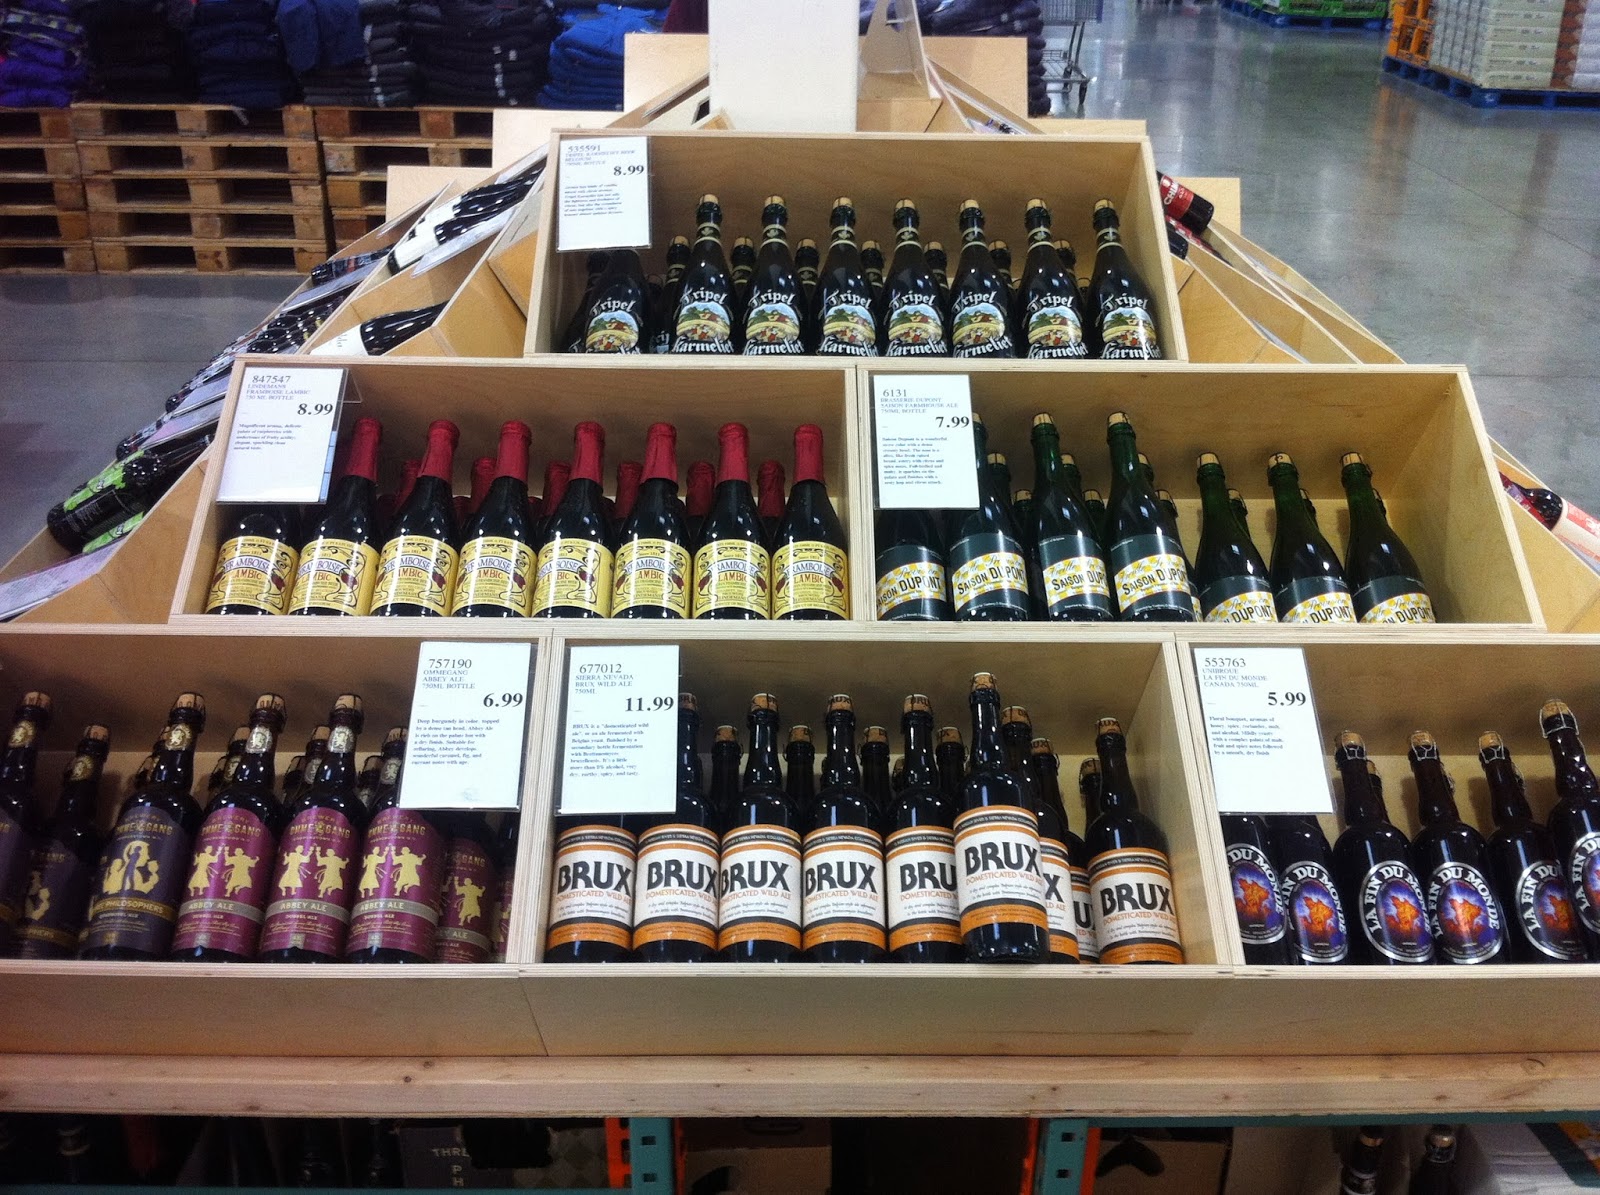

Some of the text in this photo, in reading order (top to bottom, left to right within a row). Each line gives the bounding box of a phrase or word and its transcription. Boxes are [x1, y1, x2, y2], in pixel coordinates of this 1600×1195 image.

[568, 145, 601, 153] 535591
[613, 165, 644, 176] 8.99
[680, 287, 728, 305] Tripel
[750, 289, 796, 307] Tripel
[826, 289, 872, 309] Tripel
[889, 291, 936, 310] Tripel
[952, 291, 996, 313] Tripel
[1028, 292, 1073, 312] Tripel
[1102, 292, 1148, 311] Tripel
[592, 297, 636, 317] Tripel
[883, 389, 907, 397] 6131
[297, 403, 333, 415] 8.99
[936, 416, 969, 428] 7.99
[386, 556, 430, 571] FRMBOISE
[794, 574, 824, 584] LAMBIC
[957, 572, 988, 595] SAISON
[1052, 574, 1084, 591] SAISON
[1122, 569, 1187, 596] SAISON DUPON
[877, 576, 940, 609] AISON DUPONT
[1232, 604, 1273, 623] DUPONT
[1310, 605, 1353, 623] DUPONT
[1398, 605, 1435, 623] DUPONT
[429, 659, 472, 669] 757190
[579, 664, 622, 674] 677012
[1205, 658, 1246, 667] 553763
[483, 693, 523, 707] 6.99
[625, 696, 674, 712] 11.99
[1268, 692, 1306, 706] 5.99
[964, 841, 1042, 878] BRUX
[1572, 853, 1586, 883] FIN
[558, 860, 632, 898] BRUX
[647, 858, 718, 899] BRUX
[721, 861, 790, 898] BRUX
[805, 861, 877, 897] BRUX
[900, 861, 956, 892] BRU
[965, 871, 1034, 886] DOMESTICATED WILD
[1379, 865, 1404, 879] DU
[1228, 848, 1254, 862] DU
[1255, 855, 1285, 916] MONDE
[1364, 876, 1383, 905] FIN
[1521, 876, 1539, 905] FIN
[556, 890, 622, 903] DOMESTICATED WILD
[646, 889, 696, 899] DOMESTICATED
[721, 890, 760, 904] MESTICATED
[781, 892, 791, 900] ALE
[851, 890, 868, 898] WILD
[869, 894, 878, 902] ALE
[901, 891, 952, 901] DOMESTICATED
[1100, 883, 1174, 917] BRUX
[1293, 866, 1319, 880] DU
[1319, 874, 1348, 935] MONDE
[1428, 882, 1441, 911] FIN
[1438, 867, 1463, 883] DU
[1464, 870, 1500, 930] MONDE
[1575, 887, 1591, 912] LA
[106, 901, 164, 914] PHILOSOPHERS
[188, 901, 234, 910] ABBEY ALE
[280, 901, 328, 912] ABBEY ALE
[360, 901, 405, 912] ABBEY ALE
[1055, 903, 1067, 912] ALE
[1103, 911, 1152, 926] DOMESTICATED
[1366, 912, 1382, 933] LA
[1523, 909, 1541, 932] LA
